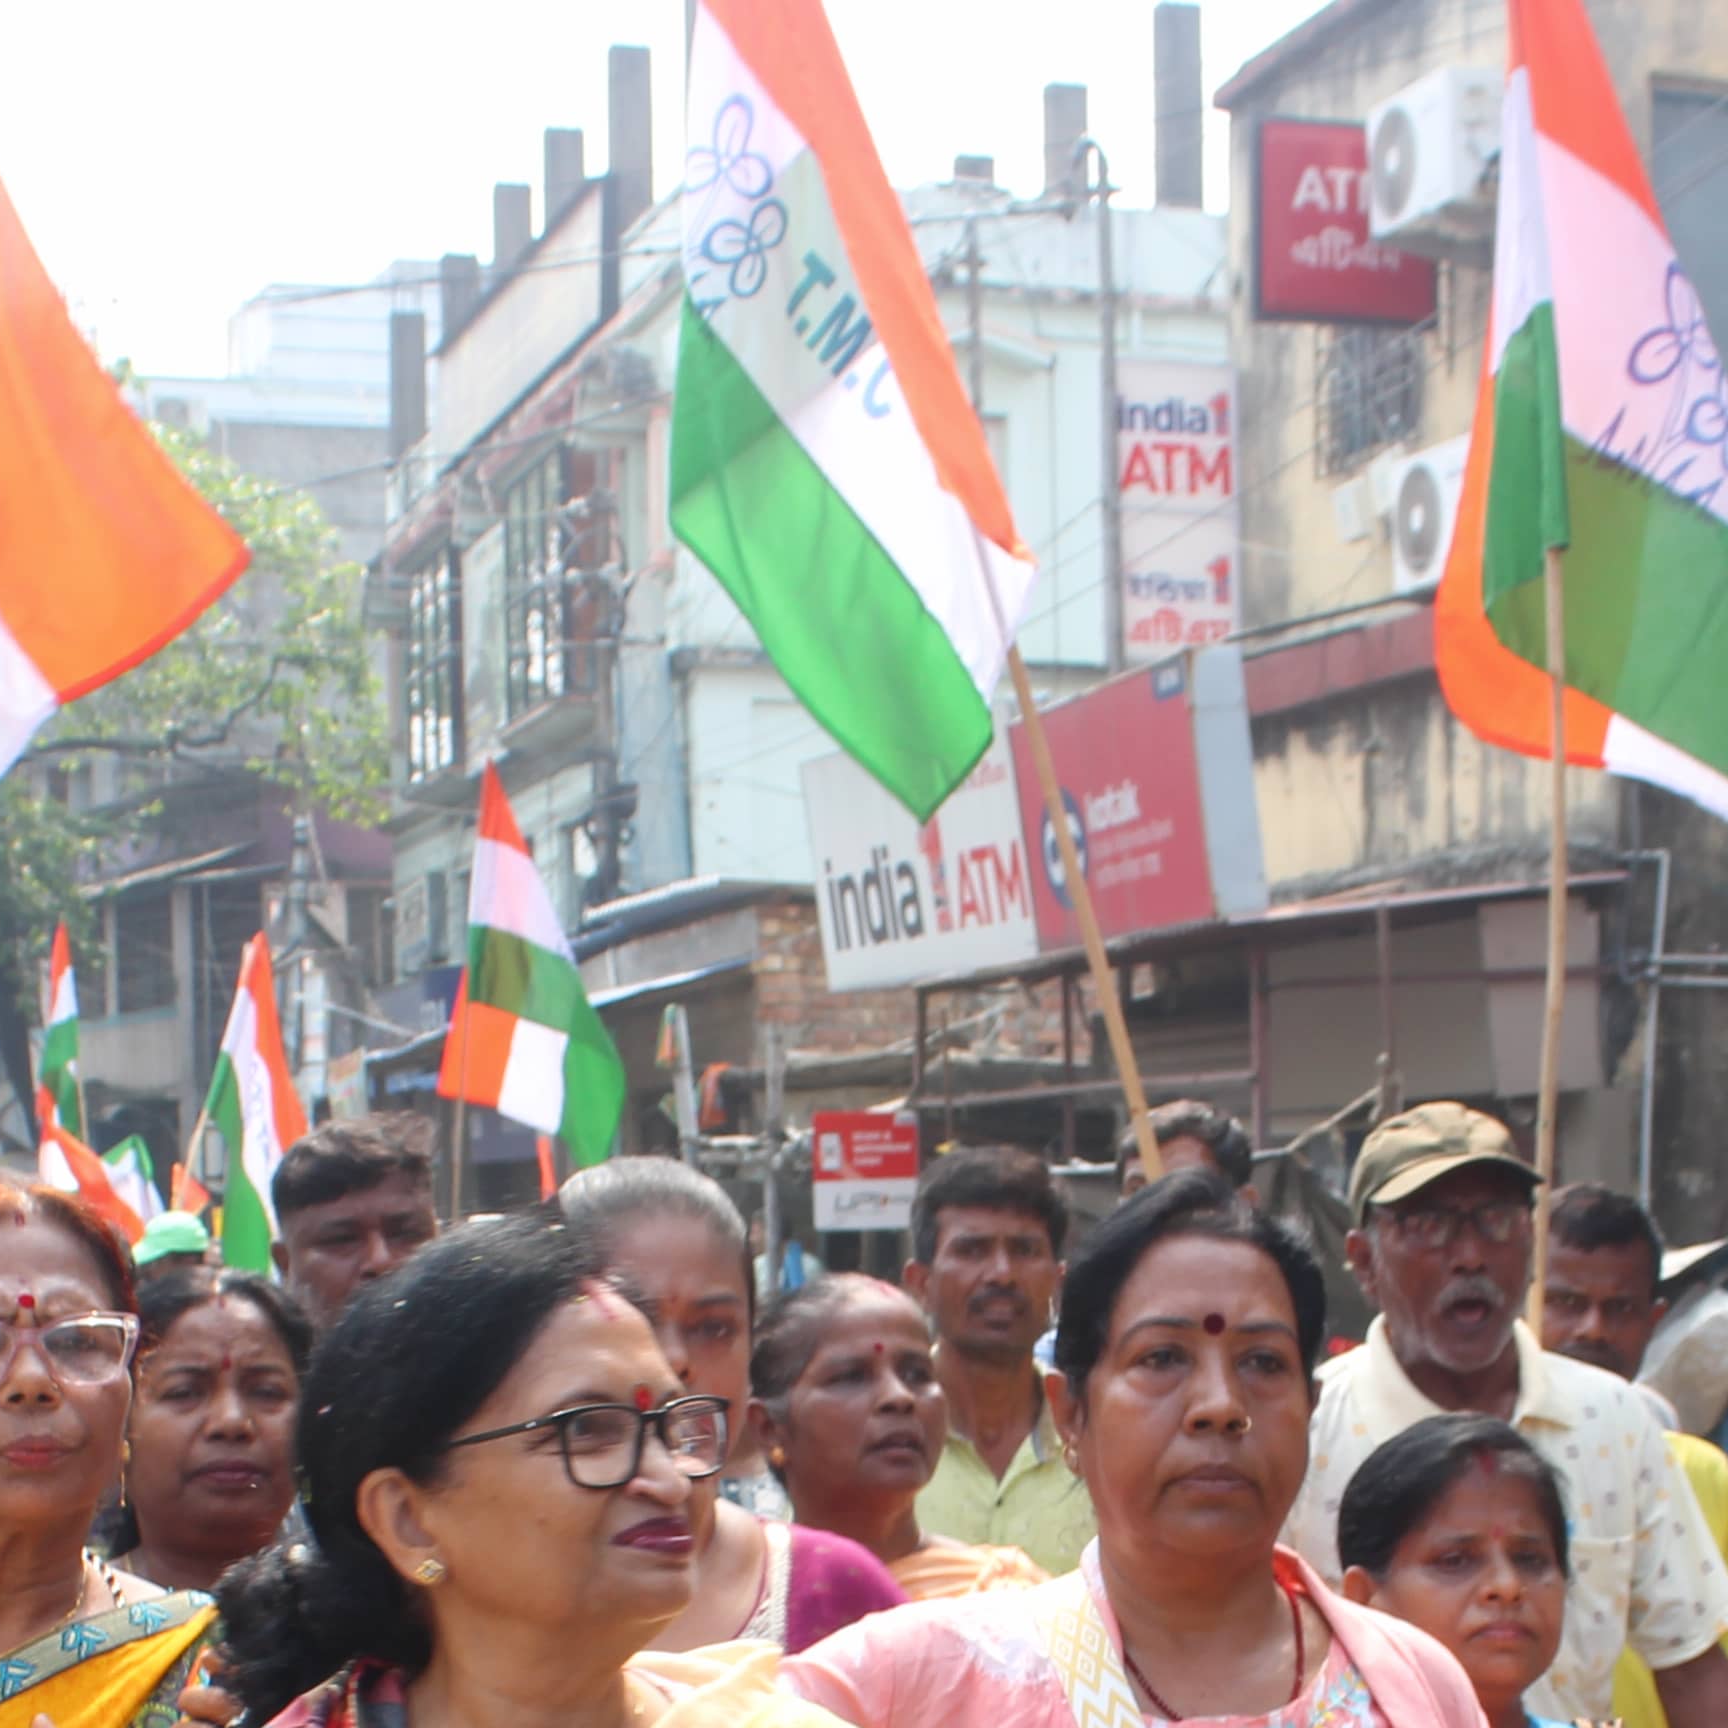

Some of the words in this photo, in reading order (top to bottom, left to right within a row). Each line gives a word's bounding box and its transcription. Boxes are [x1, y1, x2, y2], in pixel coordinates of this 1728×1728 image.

[1290, 165, 1372, 213] AT
[1120, 442, 1232, 496] ATM
[957, 838, 1029, 930] ATM
